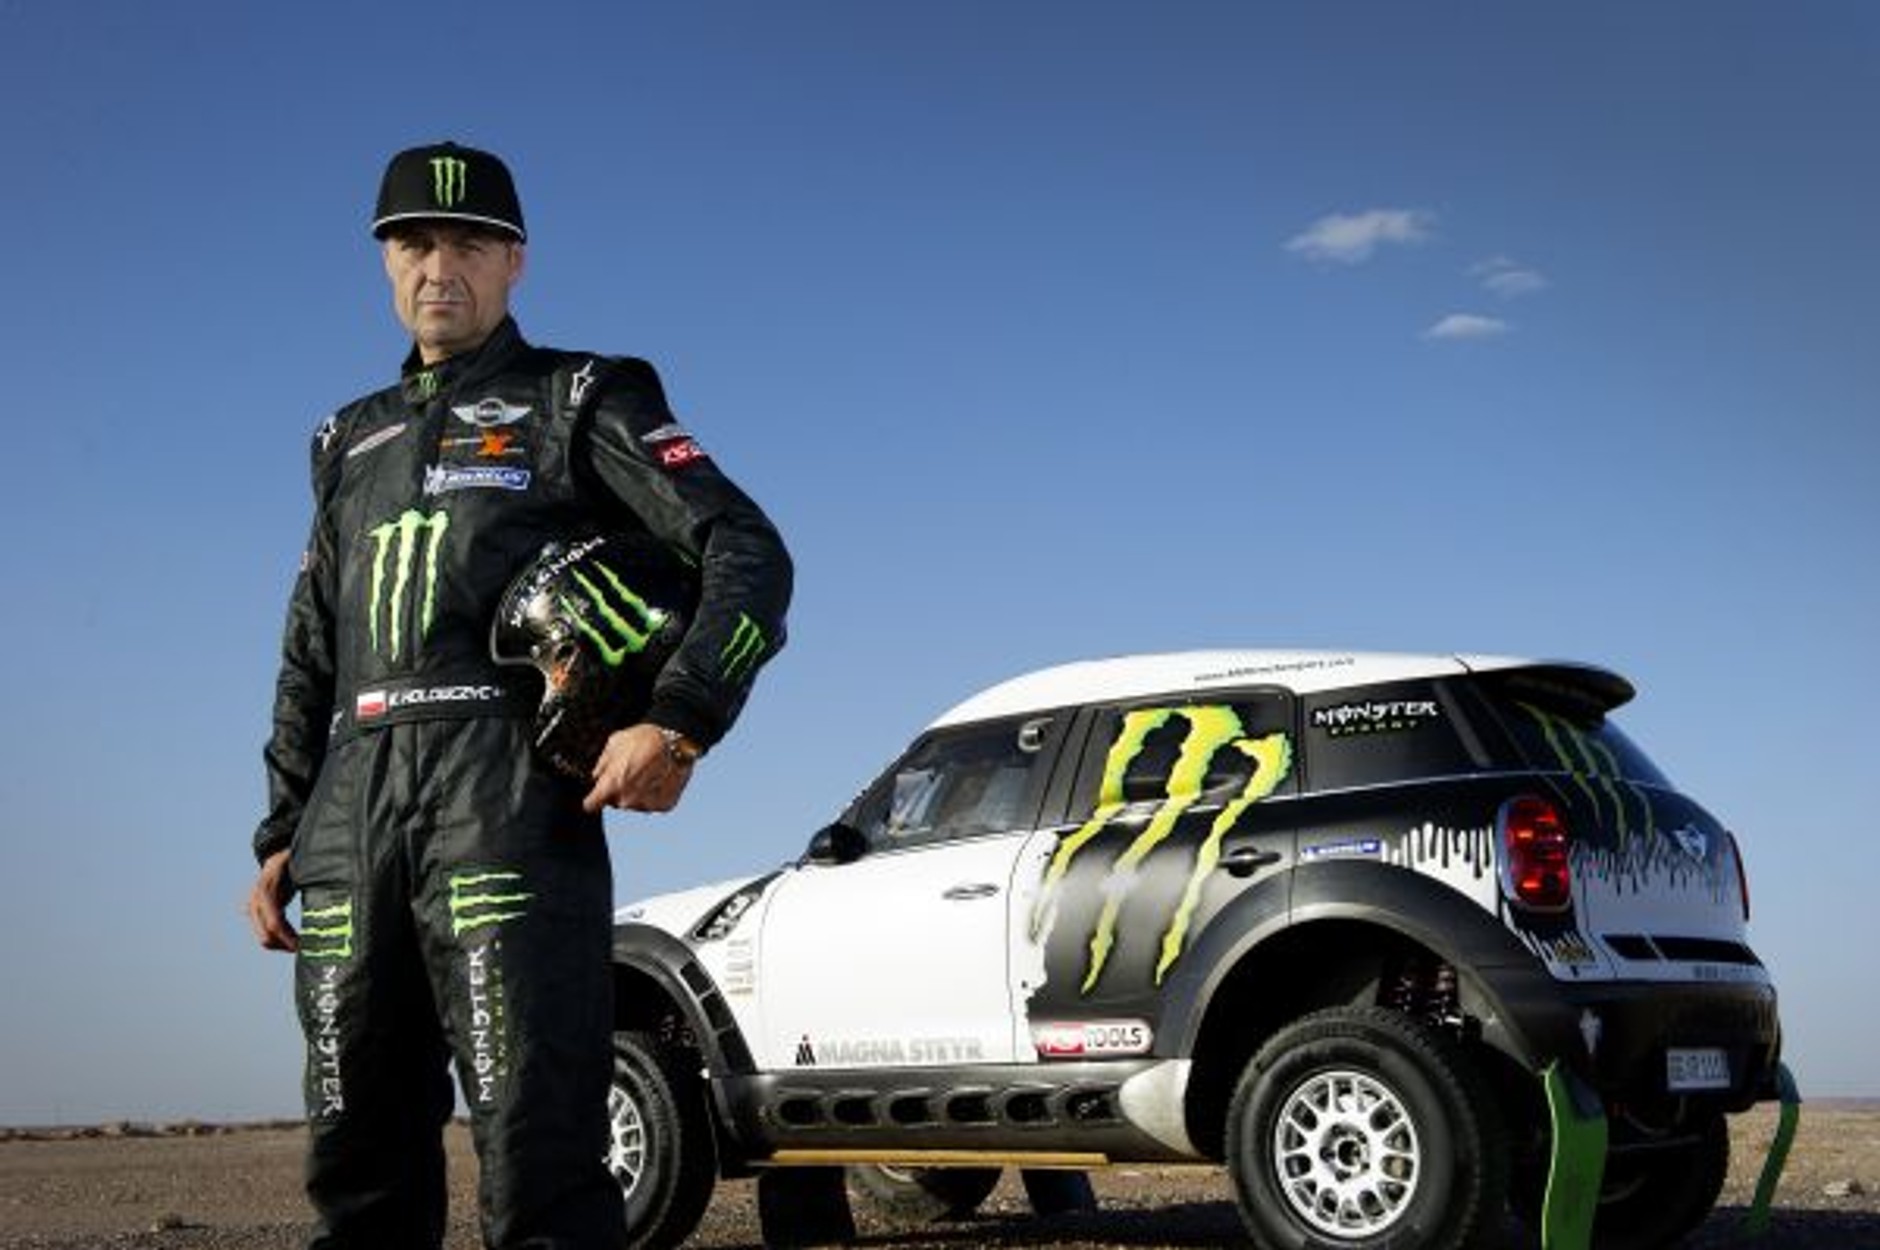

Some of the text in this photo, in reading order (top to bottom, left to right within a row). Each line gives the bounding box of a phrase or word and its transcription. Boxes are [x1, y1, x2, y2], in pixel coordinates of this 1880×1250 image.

[1316, 701, 1438, 725] MONSTER
[469, 945, 495, 1103] MONSTER
[317, 964, 344, 1117] MONSTER
[1086, 1027, 1143, 1048] TOOLS
[818, 1039, 905, 1064] MAGNA
